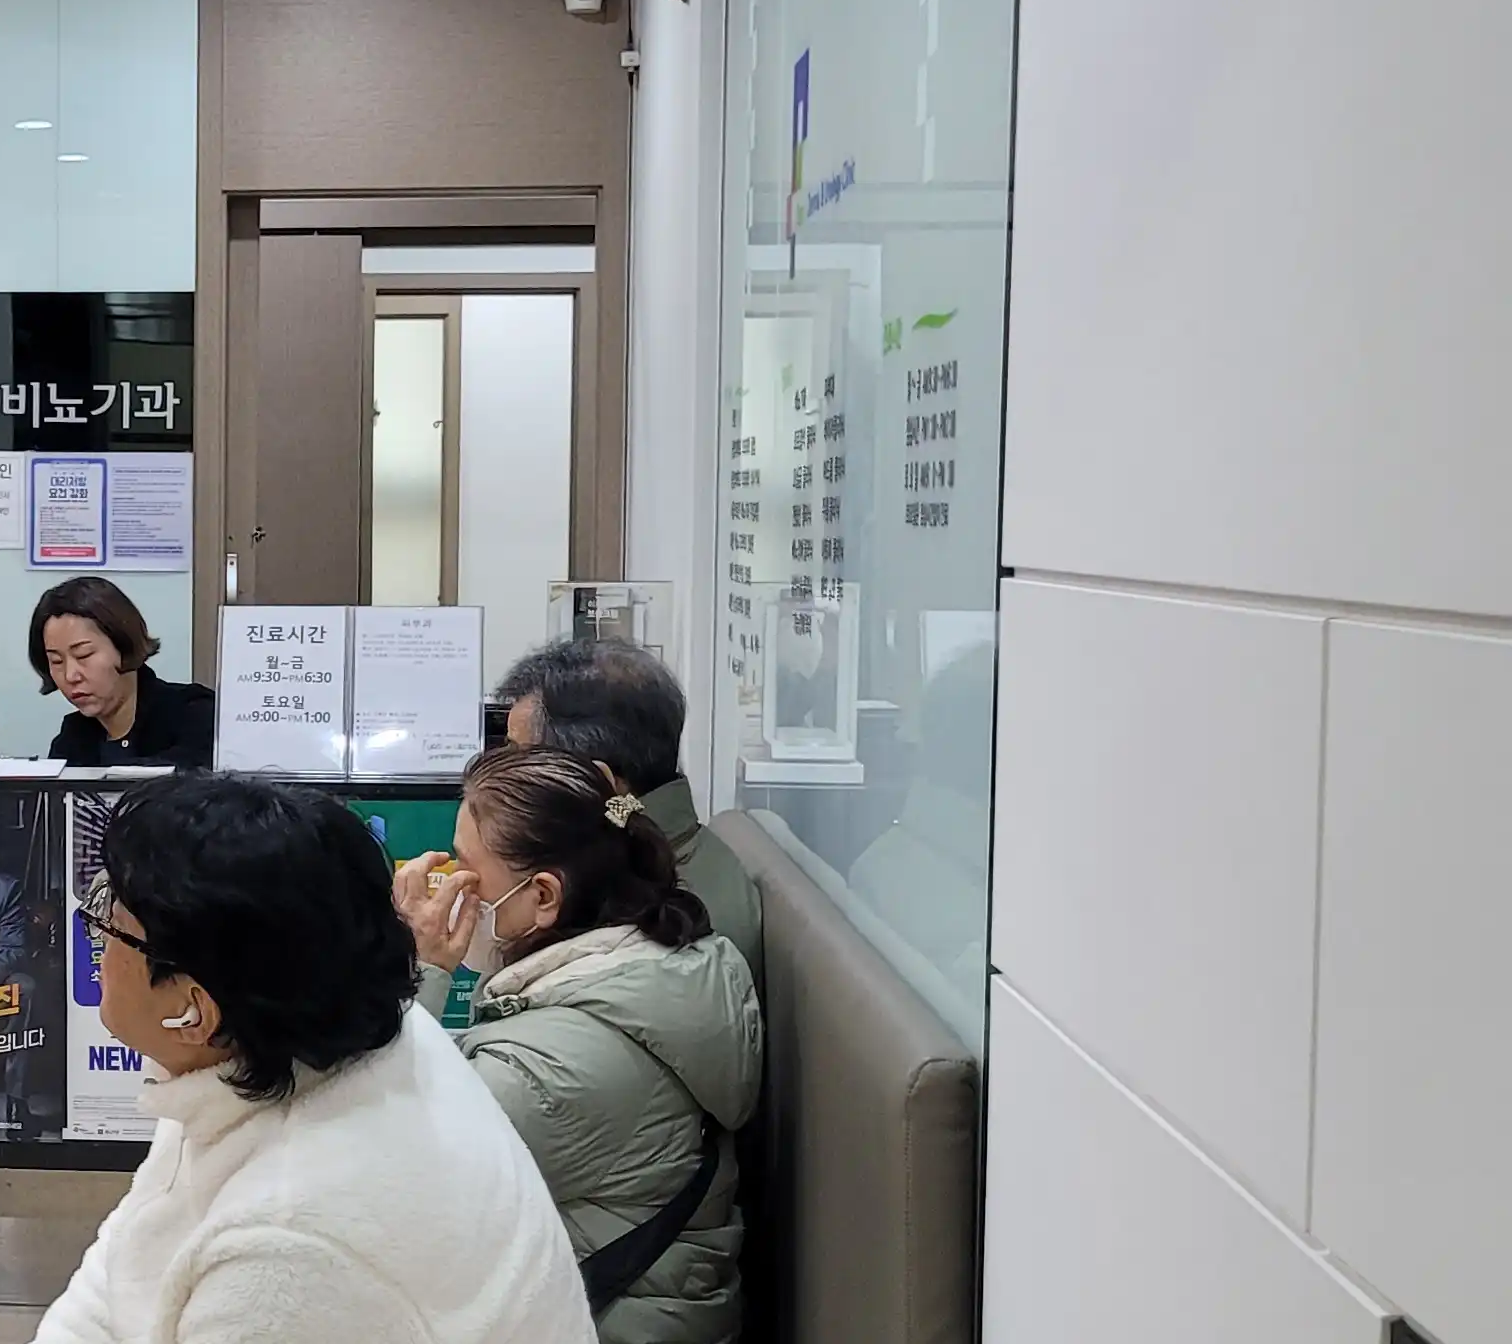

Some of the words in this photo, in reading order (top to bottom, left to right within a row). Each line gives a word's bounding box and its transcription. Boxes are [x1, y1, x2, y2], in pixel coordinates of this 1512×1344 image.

[246, 624, 328, 644] 진료시간
[265, 655, 304, 670] 월~금
[237, 671, 332, 683] AM9:30~PM6:30
[261, 695, 305, 710] 토요일
[236, 710, 331, 723] AM9:00~PM1:00
[88, 1045, 143, 1072] NEW
